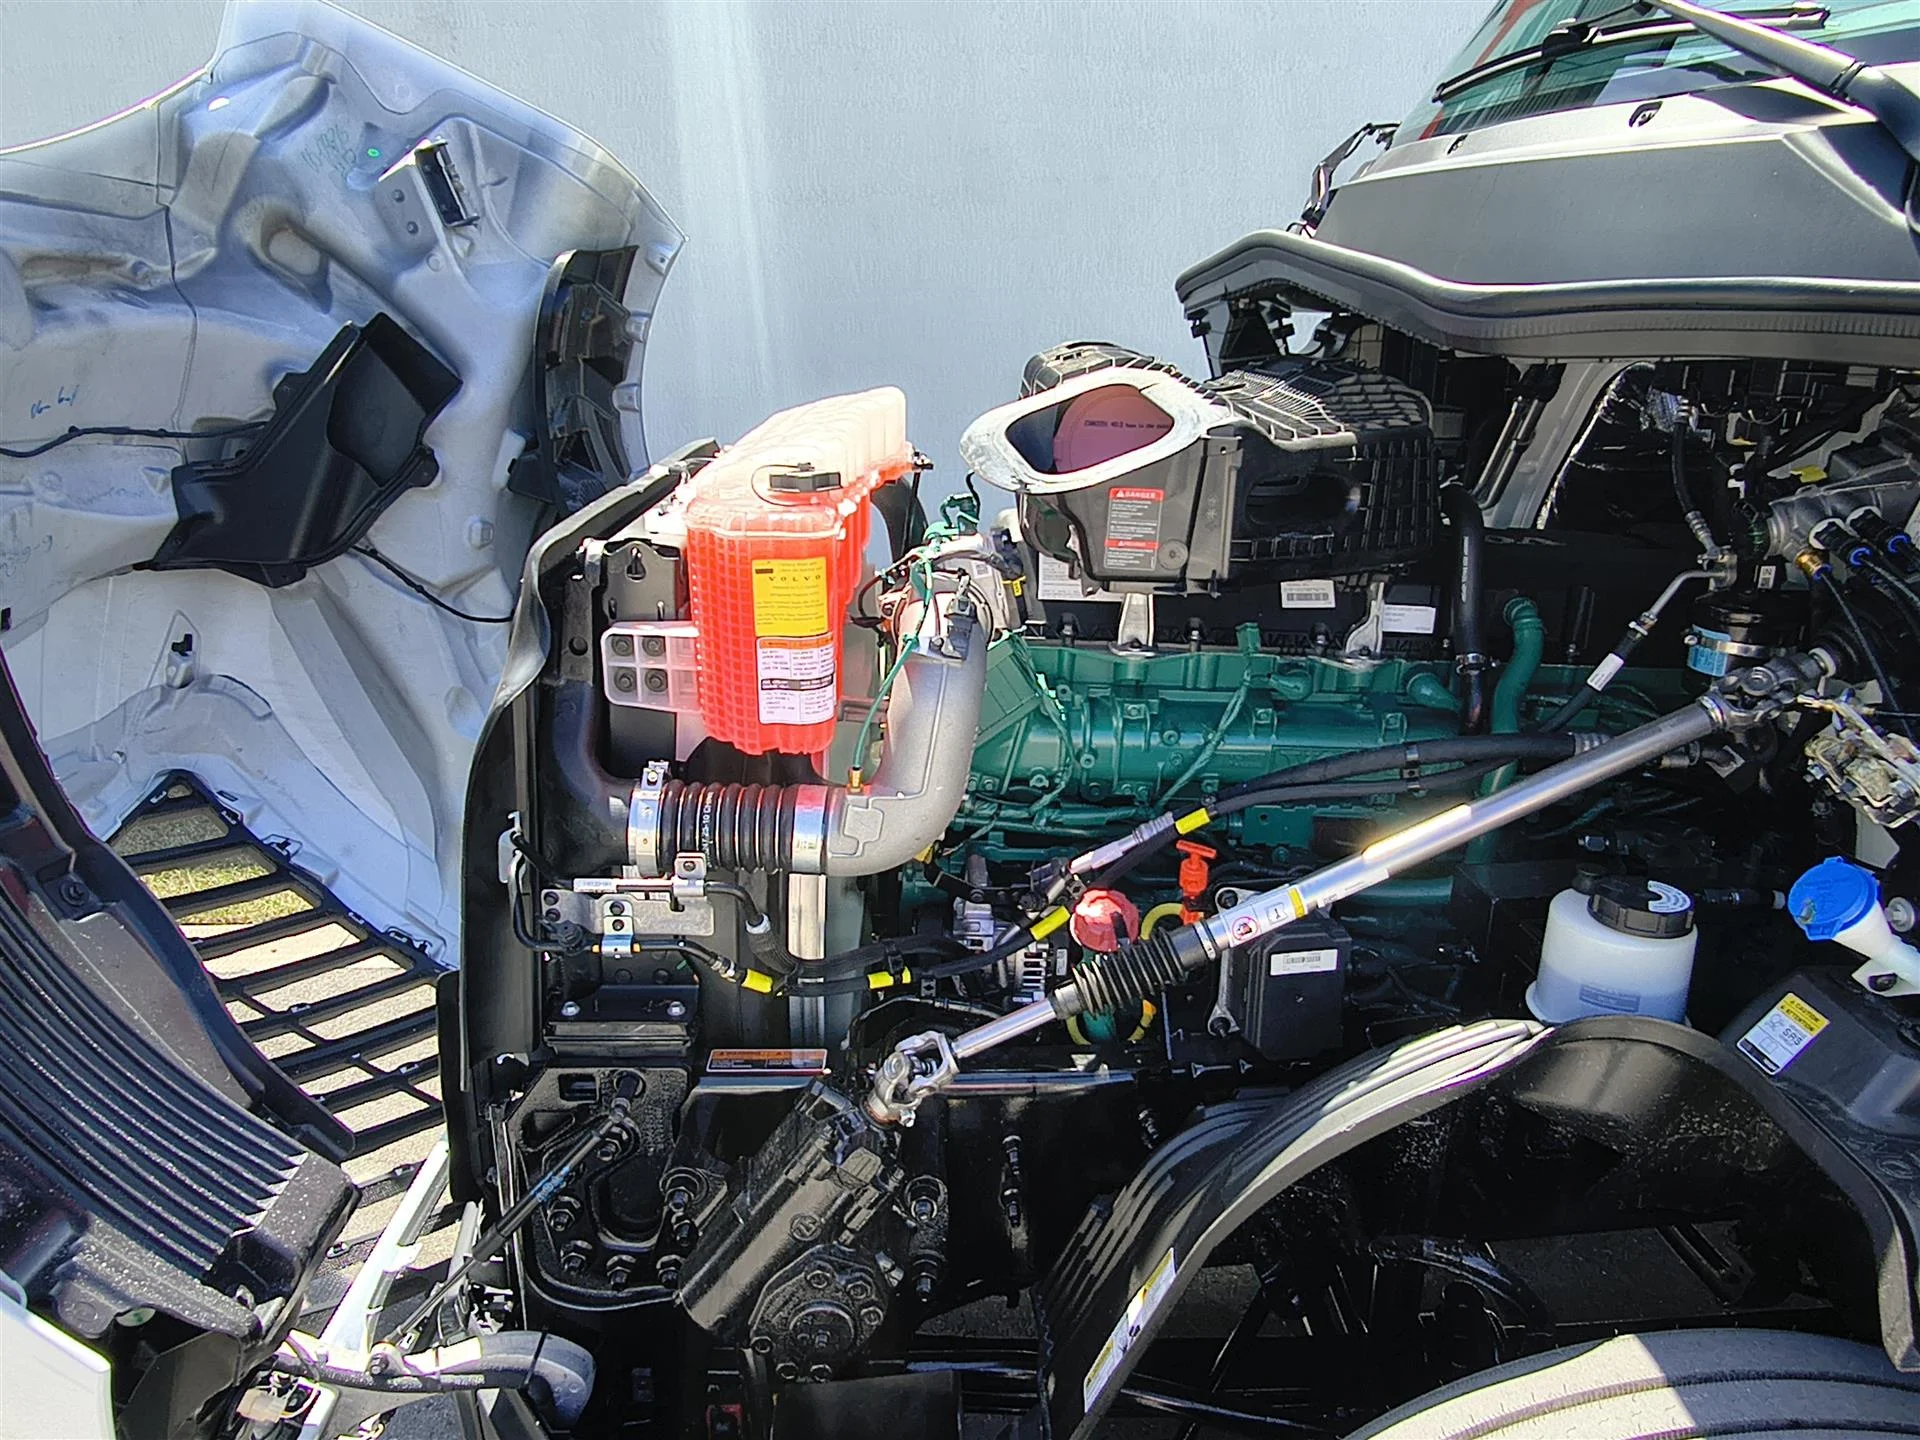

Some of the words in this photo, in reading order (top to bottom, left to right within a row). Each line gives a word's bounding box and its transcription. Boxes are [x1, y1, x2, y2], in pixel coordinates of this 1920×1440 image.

[1125, 491, 1156, 499] DANGER
[768, 574, 821, 582] VOLVO
[1795, 1002, 1821, 1022] CAUTION
[1782, 1027, 1804, 1046] SRS
